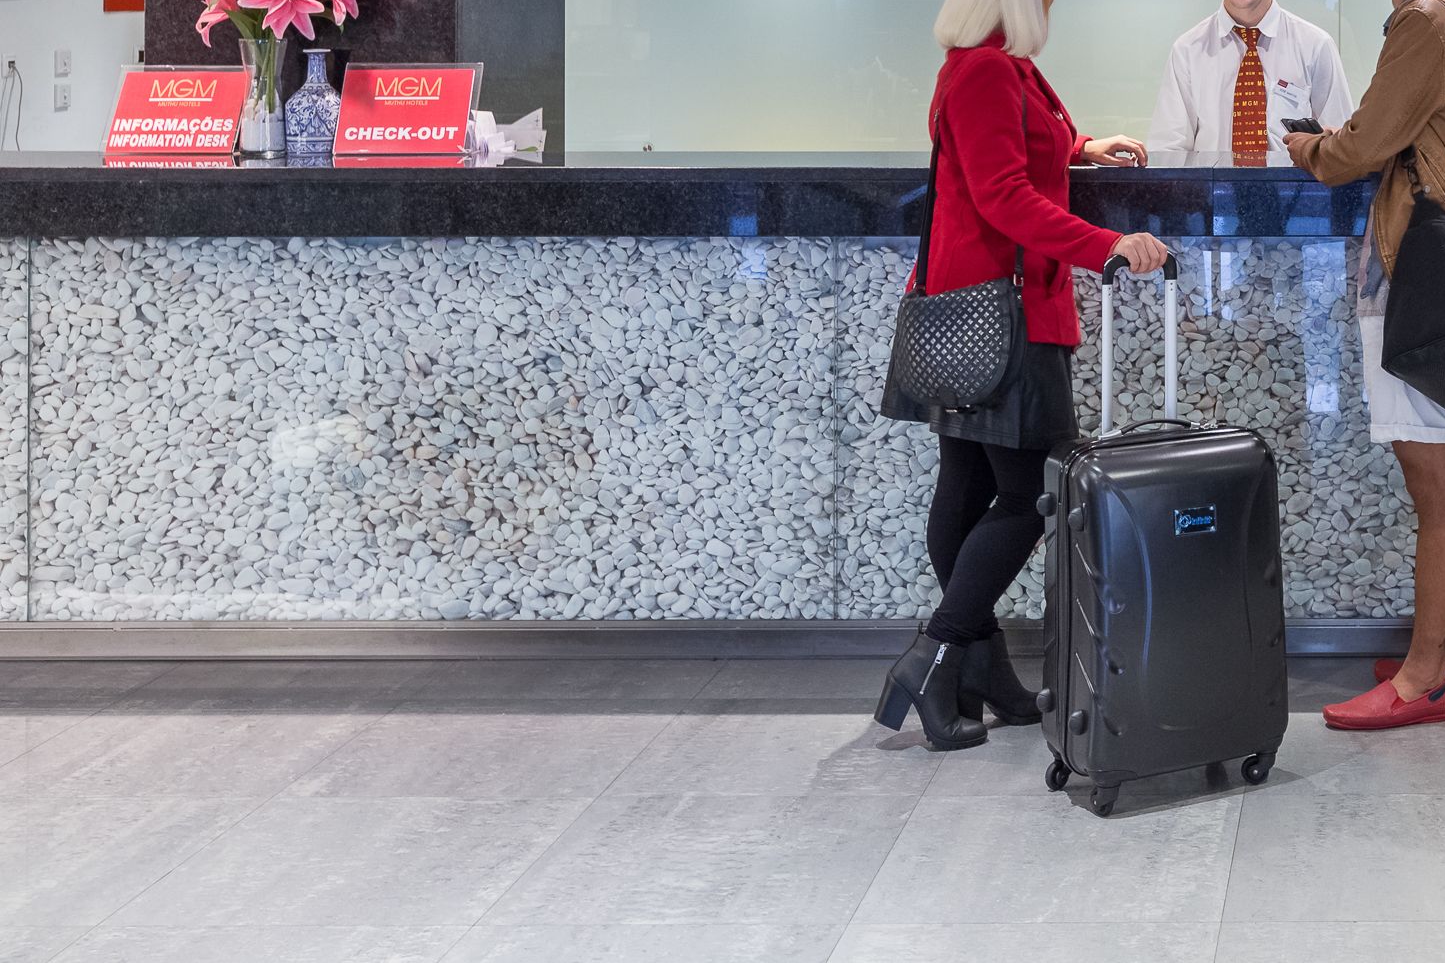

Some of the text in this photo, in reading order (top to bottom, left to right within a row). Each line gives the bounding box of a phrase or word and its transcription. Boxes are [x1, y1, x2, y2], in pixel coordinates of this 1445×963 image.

[150, 79, 218, 97] MGM
[375, 77, 442, 96] MGM
[113, 116, 234, 134] INFORMAÇÕES
[345, 127, 458, 140] CHECK-OUT
[109, 134, 229, 147] INFORMATION DESK
